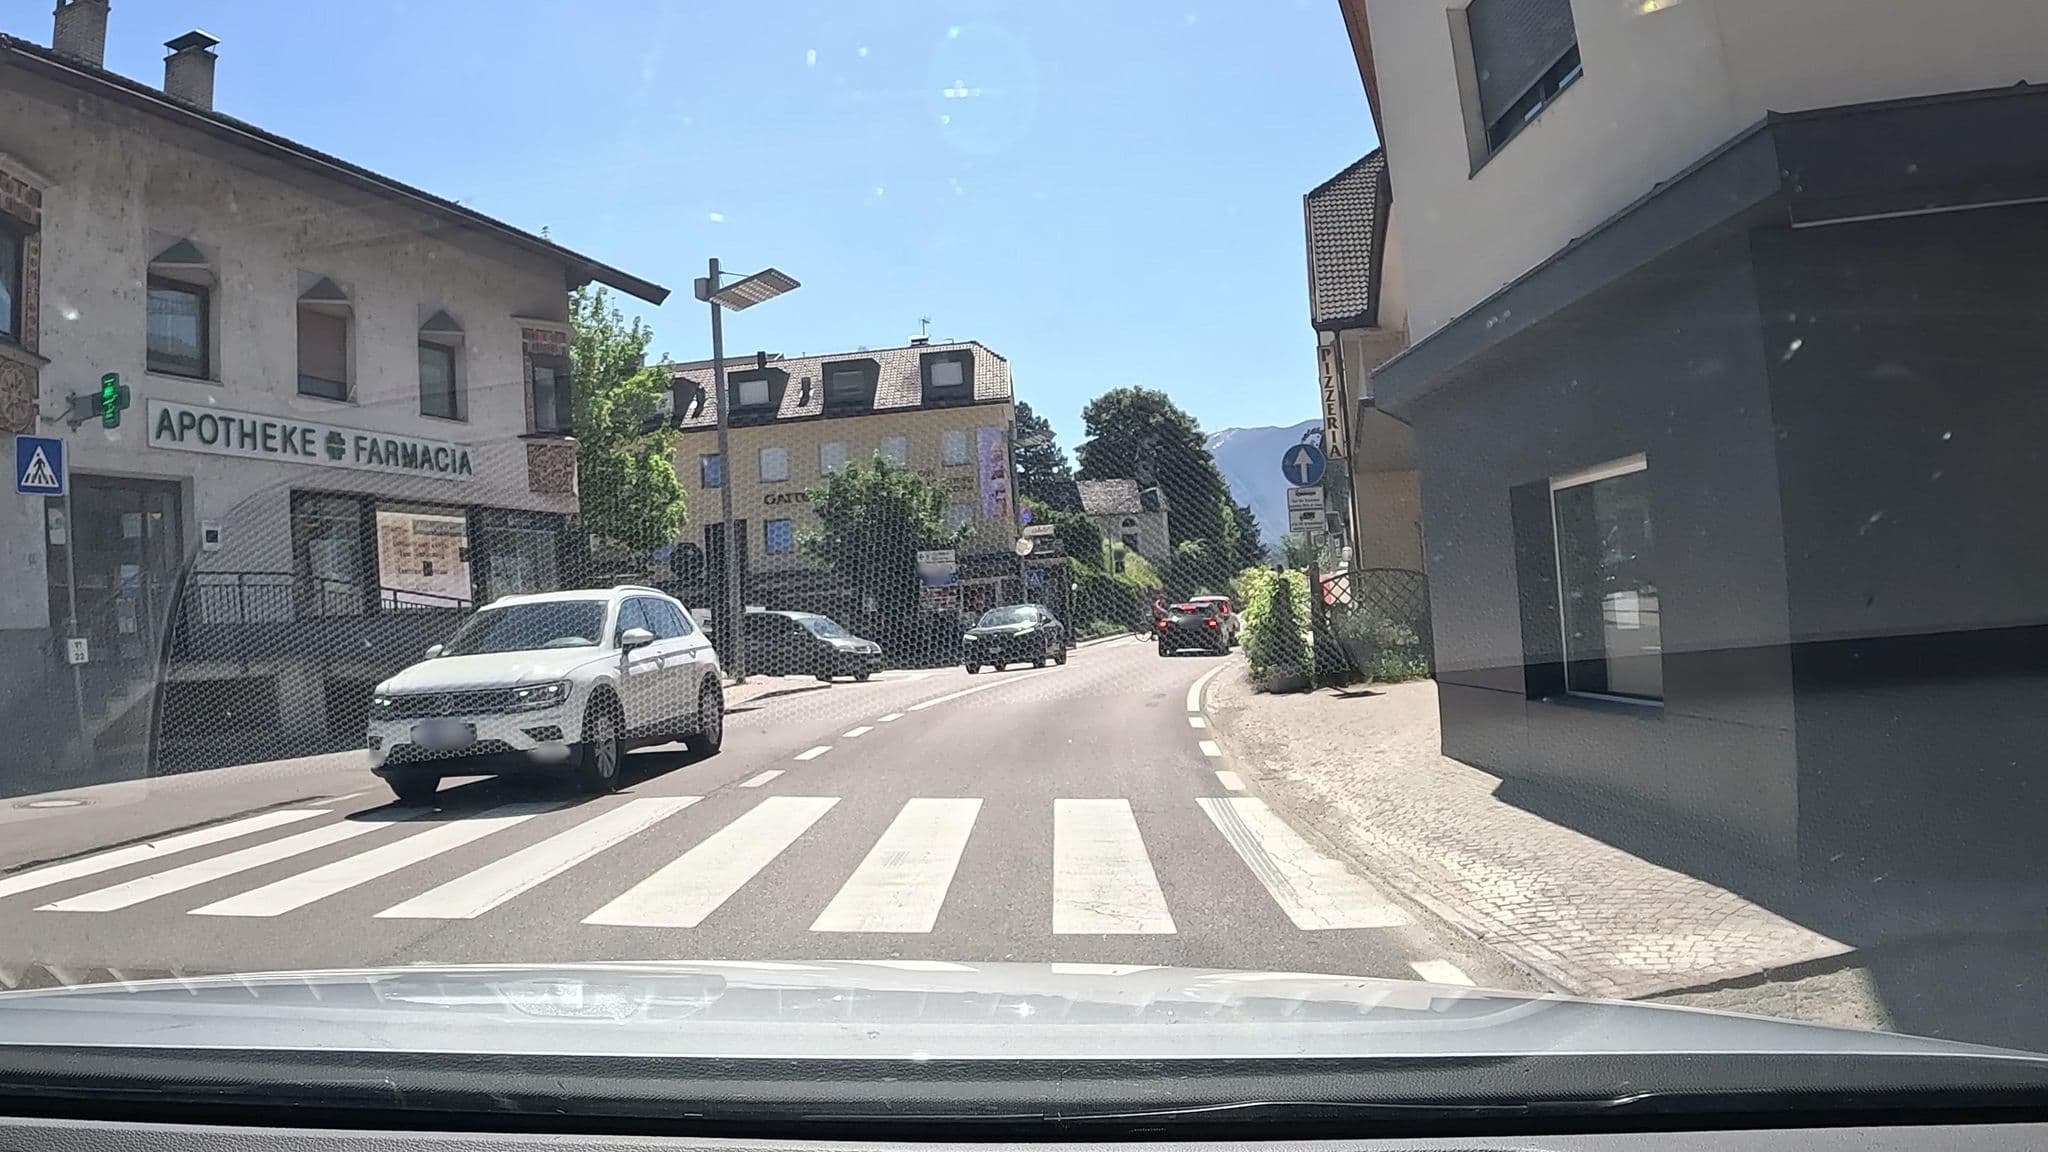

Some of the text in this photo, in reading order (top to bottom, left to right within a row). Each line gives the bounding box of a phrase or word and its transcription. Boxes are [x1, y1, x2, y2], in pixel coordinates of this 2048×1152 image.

[155, 407, 473, 476] APOTHEKE FARMACIA
[1321, 348, 1342, 458] PIZZERIA
